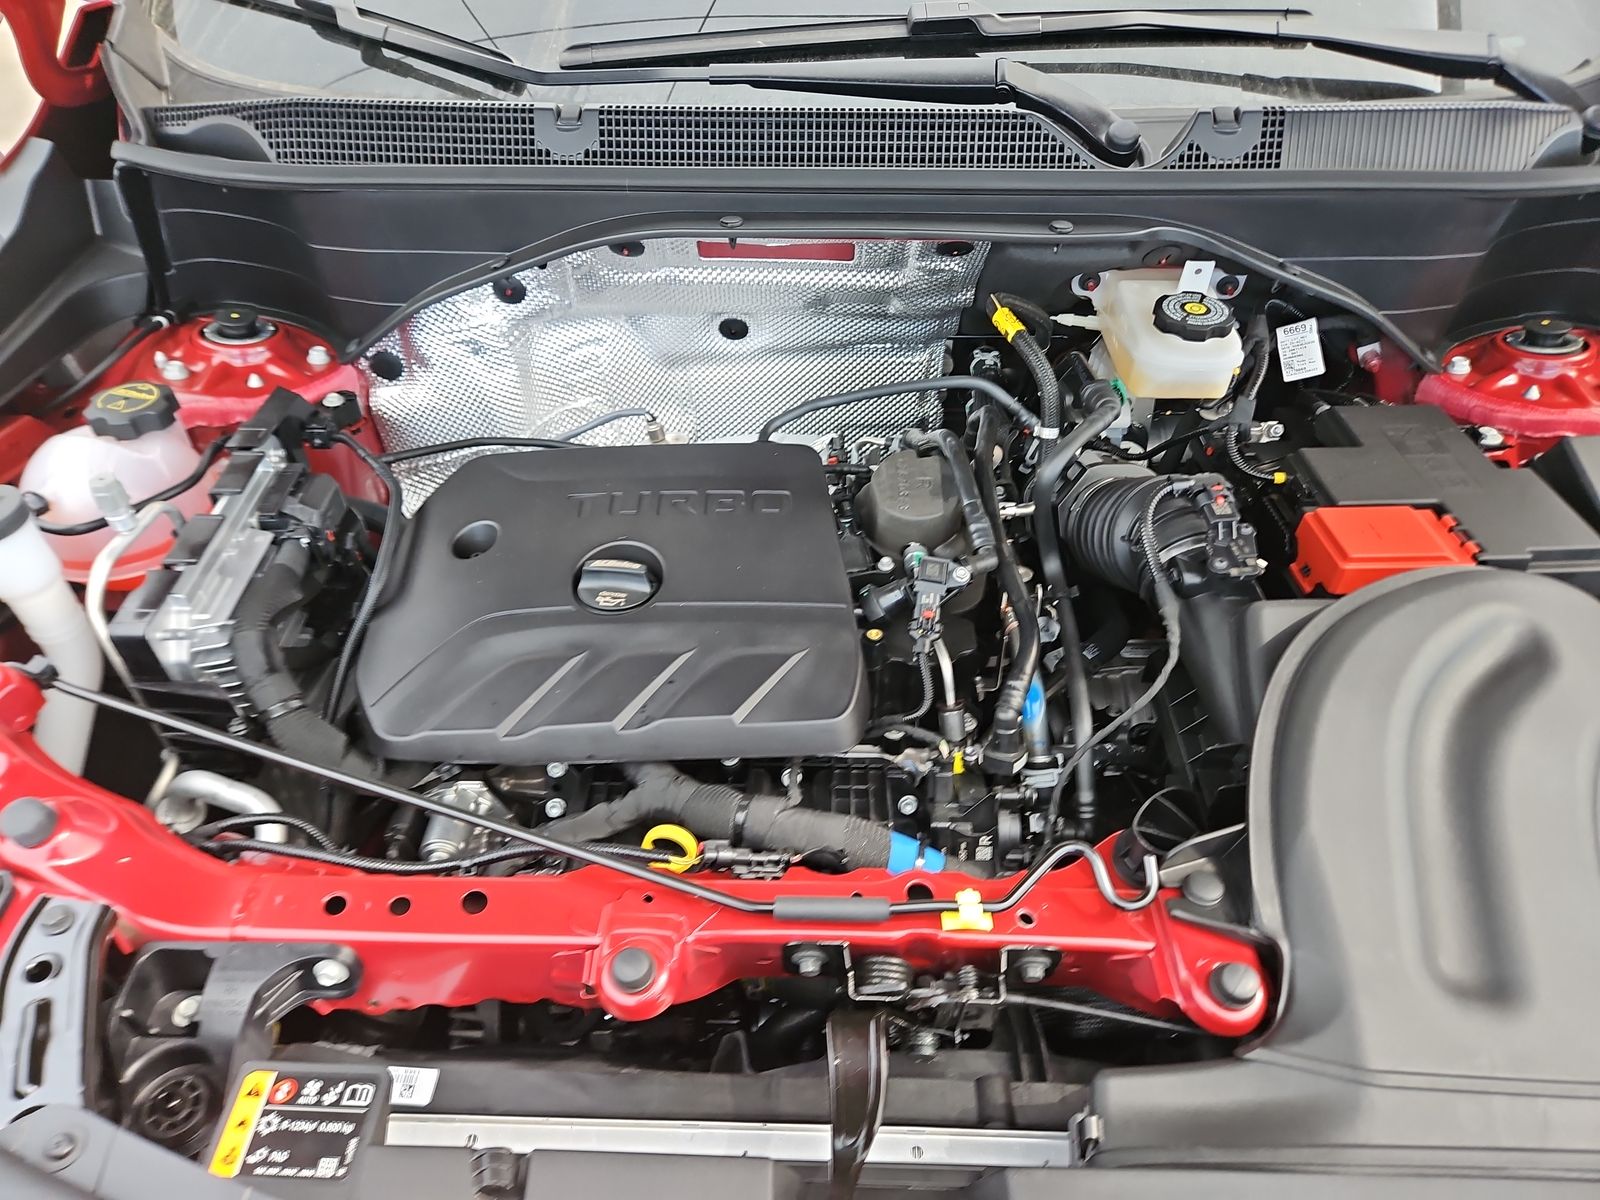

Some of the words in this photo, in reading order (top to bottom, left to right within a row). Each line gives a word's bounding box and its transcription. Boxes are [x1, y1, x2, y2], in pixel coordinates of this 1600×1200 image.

[1283, 324, 1307, 335] 6669
[567, 489, 792, 518] TURBO
[296, 1095, 320, 1104] AUTO
